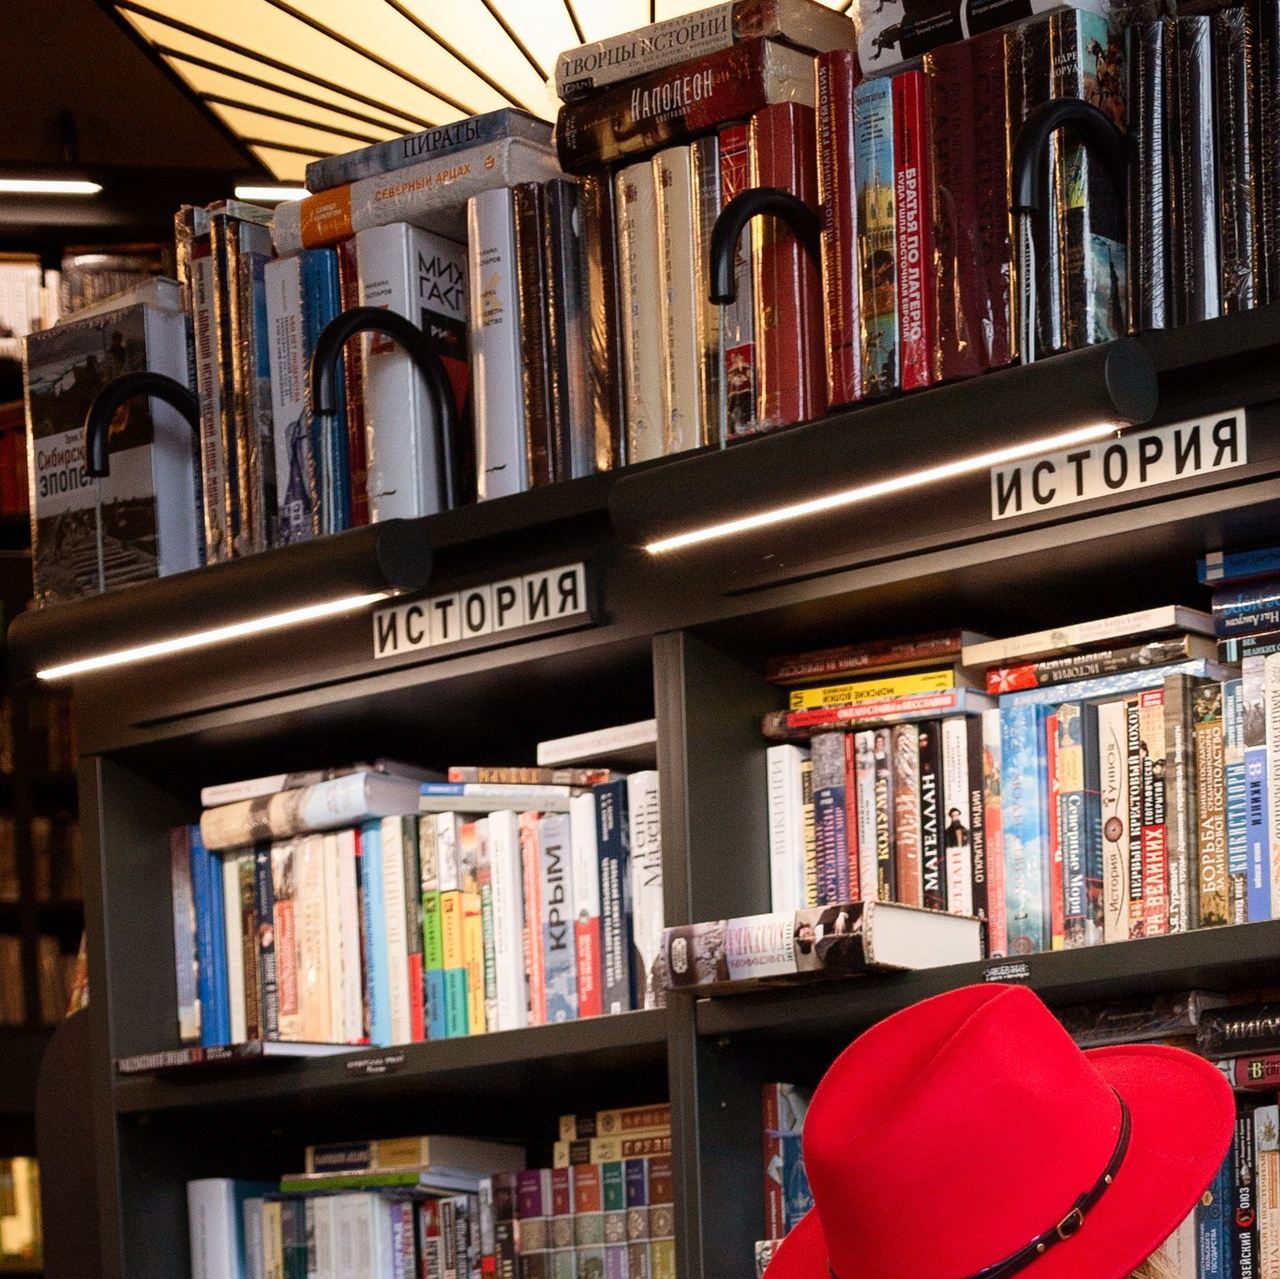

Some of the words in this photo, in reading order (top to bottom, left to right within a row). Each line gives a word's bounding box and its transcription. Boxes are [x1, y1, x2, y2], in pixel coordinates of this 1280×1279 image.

[562, 43, 638, 78] ТВОРЦЫ
[642, 16, 728, 57] ИСТОРИИ
[402, 119, 481, 160] ПИРАТЫ
[375, 176, 432, 202] СЕВЕРНЫЙ
[436, 163, 470, 185] АРЦАХ
[905, 167, 917, 232] БРАТЬЯ
[907, 238, 918, 262] ПО
[909, 268, 921, 341] ЛАГЕРЮ
[996, 418, 1241, 517] ИСТОРИЯ
[378, 568, 581, 655] ИСТОРИЯ
[924, 772, 937, 892] МАГЕЛЛАН
[549, 844, 565, 952] КРЫМ
